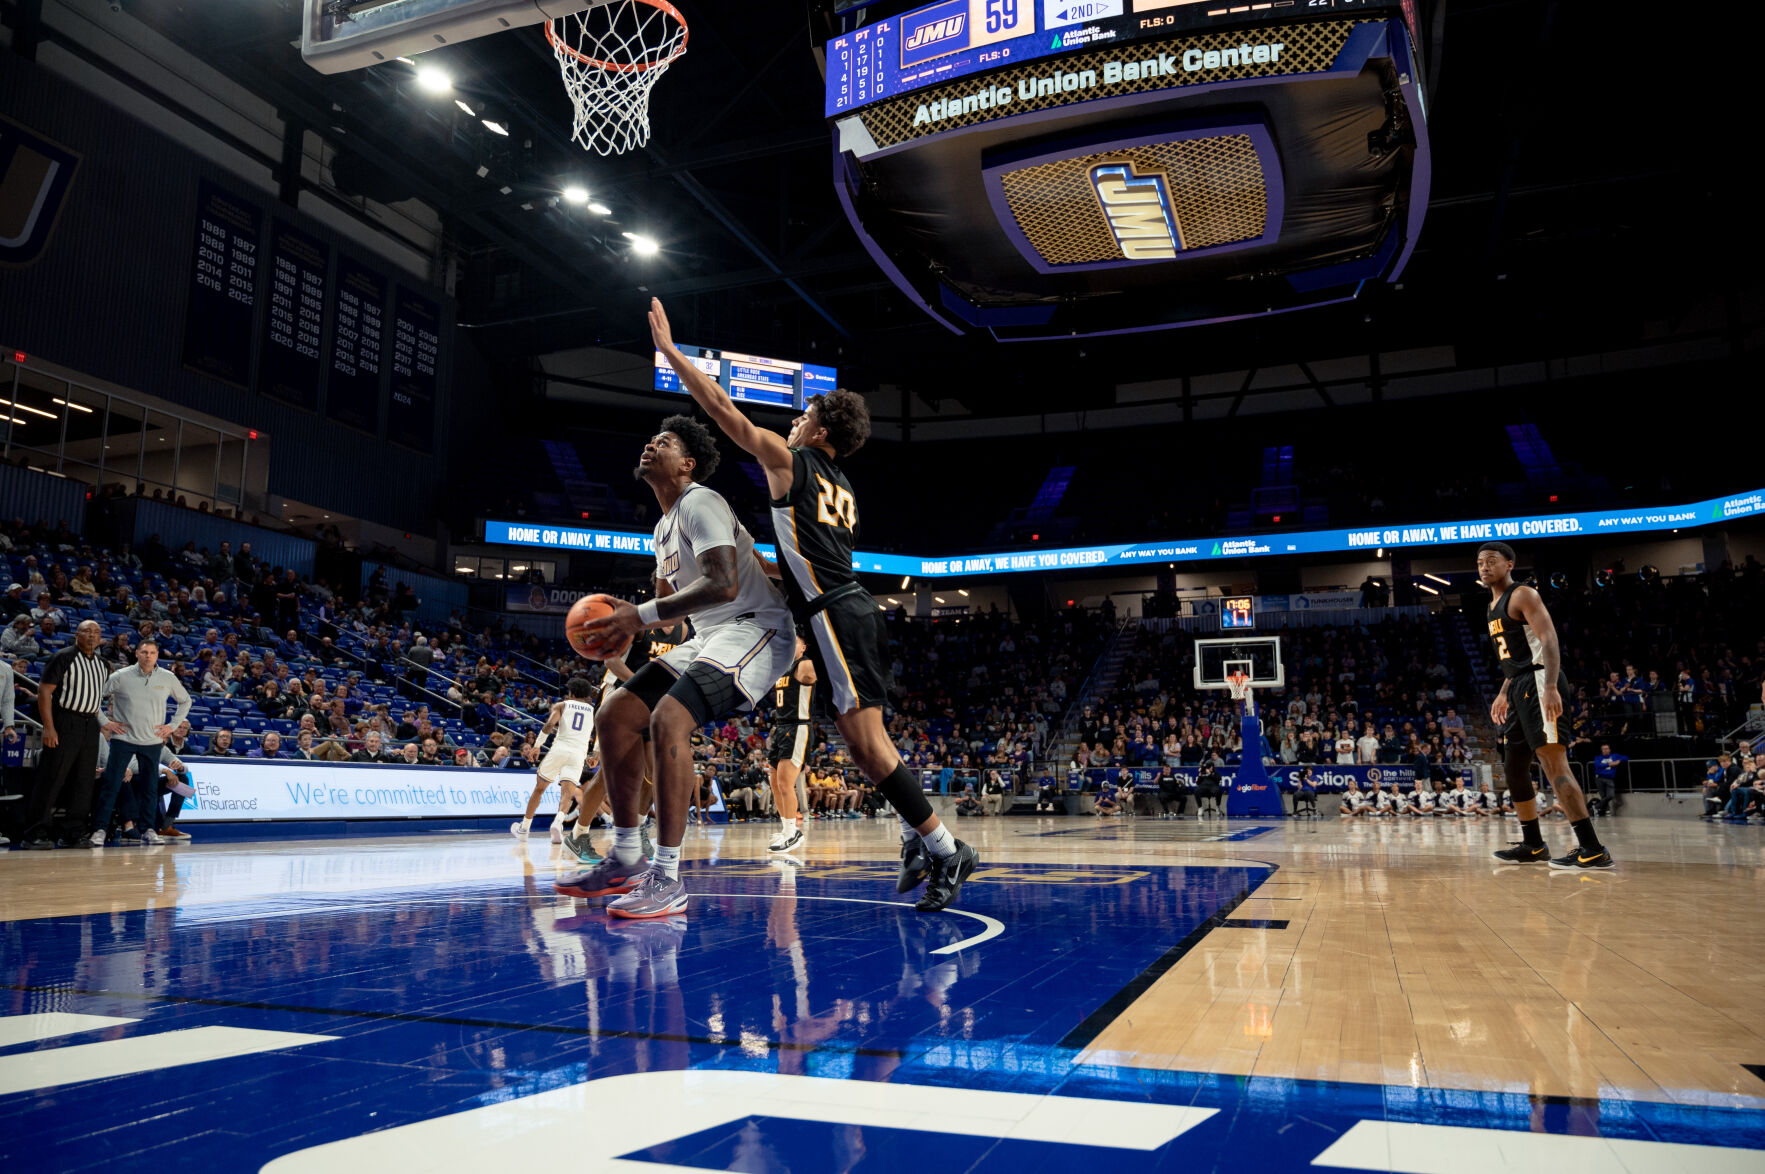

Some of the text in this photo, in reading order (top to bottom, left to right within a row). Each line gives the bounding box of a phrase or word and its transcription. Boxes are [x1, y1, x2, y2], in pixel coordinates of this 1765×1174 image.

[986, 0, 1018, 34] 59
[1071, 4, 1093, 20] 2ND
[1140, 15, 1175, 29] FLS: 0
[835, 23, 891, 50] PL PT FL
[906, 14, 965, 50] JMU
[1062, 29, 1117, 47] Union Bank
[1063, 26, 1101, 39] Atlantic
[841, 37, 884, 60] 0 2 0
[843, 49, 883, 71] 1 17 1
[979, 48, 1010, 63] FLS: 0
[840, 60, 883, 83] 4 19 1
[841, 72, 884, 95] 5 5 0
[913, 41, 1284, 127] Atlantic Union Bank Center
[836, 84, 884, 108] 21 3 0
[1096, 168, 1177, 260] JMU
[202, 219, 226, 239] 1986
[232, 235, 256, 253] 1987
[200, 232, 225, 252] 1988
[231, 248, 255, 267] 1989
[199, 246, 252, 278] 2010 2011
[275, 255, 323, 286] 1986 1987
[196, 273, 221, 291] 2016
[197, 260, 253, 293] 2014 2015
[274, 280, 293, 297] 1991
[272, 293, 321, 323] 2011 2014
[272, 306, 320, 335] 2015 2016
[338, 325, 380, 351] 2007 2010
[336, 337, 379, 363] 2011 2014
[705, 361, 714, 370] 32
[815, 473, 856, 534] 20
[1723, 494, 1762, 509] Atlantic
[1723, 502, 1765, 516] Union Ba
[1598, 512, 1696, 527] ANY WAY YOU BANK
[508, 527, 656, 552] HOME OR AWAY, WE HAVE YO
[1347, 518, 1583, 547] HOME OR AWAY, WE HAVE YOU COVERED.
[1138, 549, 1156, 557] WAY
[1157, 548, 1174, 556] YOU
[1175, 547, 1198, 555] BANK
[1222, 540, 1256, 549] Atlantic
[1222, 545, 1270, 555] Union Bank
[664, 550, 680, 576] MU
[921, 550, 1108, 574] HOME OR AWAY, WE HAVE YOU COVERED.
[1226, 600, 1251, 609] 17:06
[1232, 610, 1249, 626] 17
[1494, 636, 1511, 661] 2
[568, 704, 592, 713] FREEMAN
[572, 711, 585, 731] 0
[1289, 771, 1356, 787] Sction
[1383, 769, 1397, 777] the
[197, 781, 221, 796] Erie
[286, 782, 349, 805] We're
[355, 784, 444, 805] committed
[450, 787, 467, 805] to
[471, 786, 525, 809] making
[200, 796, 254, 812] Insurance
